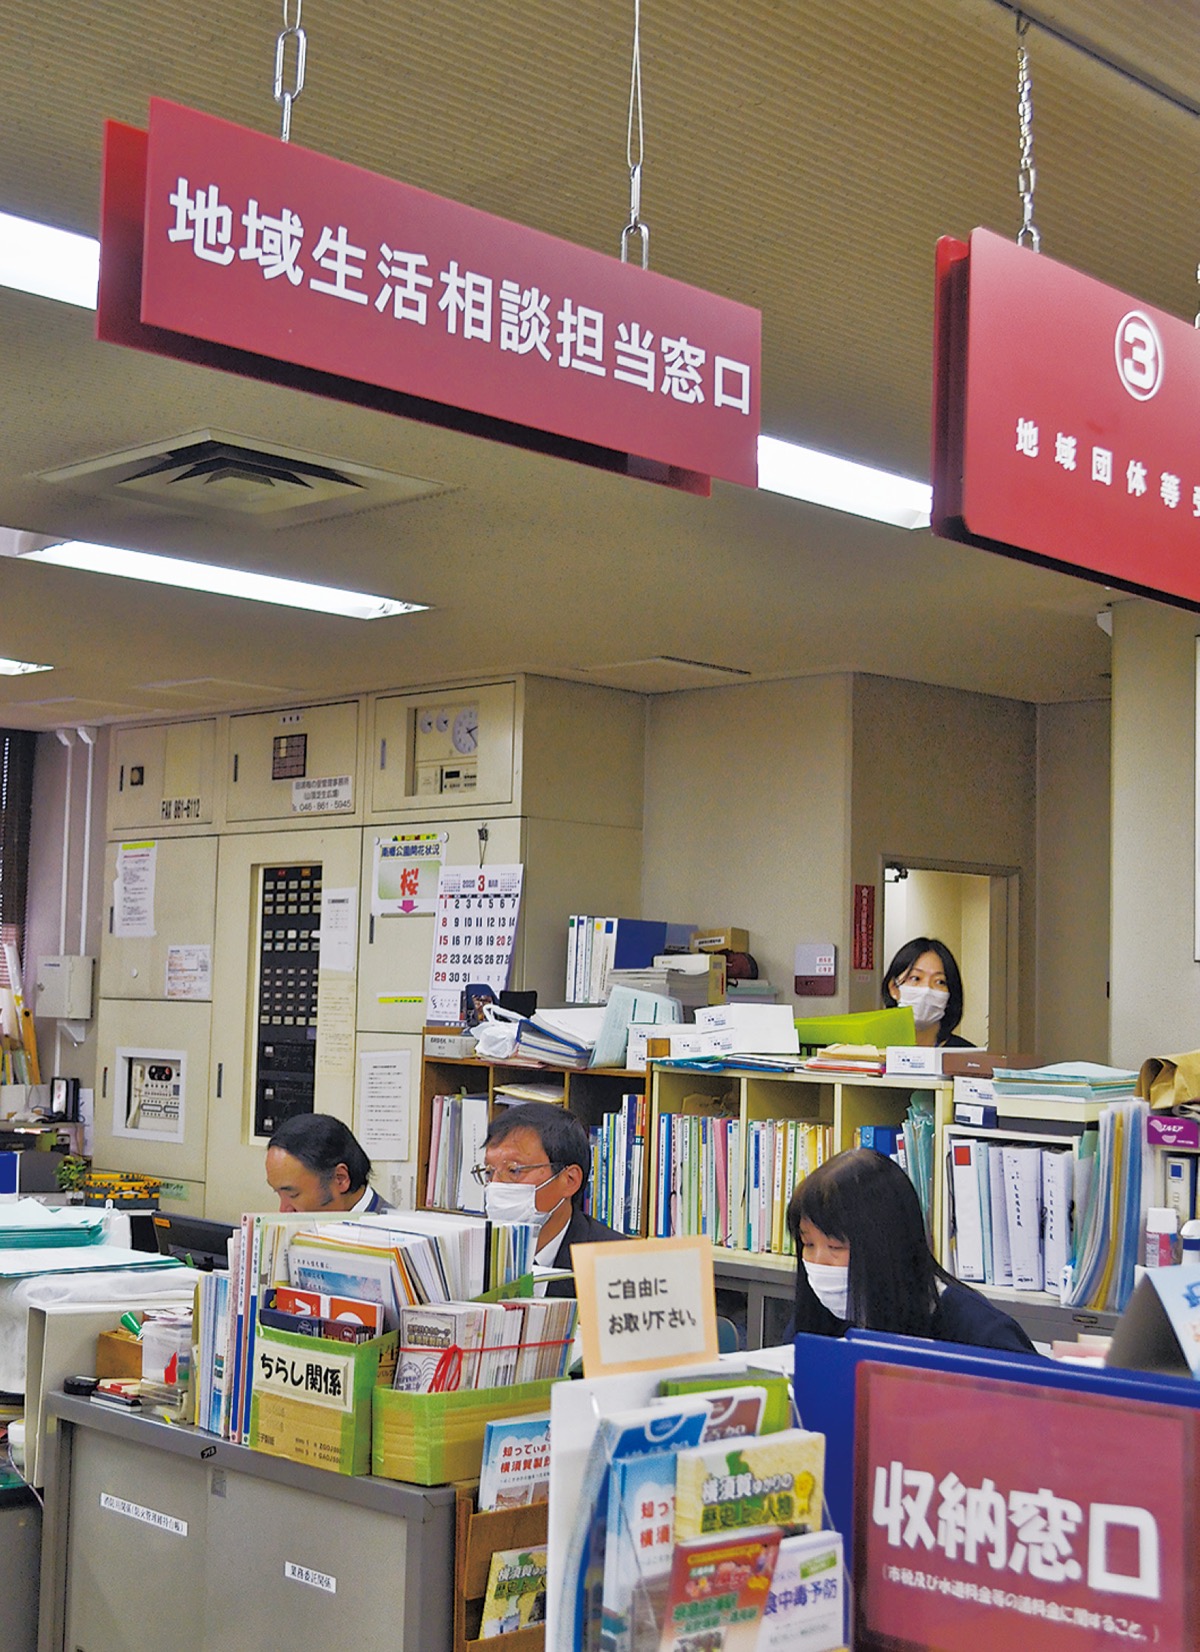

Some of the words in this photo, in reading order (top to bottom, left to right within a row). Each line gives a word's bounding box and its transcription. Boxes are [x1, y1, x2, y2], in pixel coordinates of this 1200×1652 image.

[168, 177, 751, 415] 地域生活相談担当窓口
[400, 867, 419, 896] 桜
[478, 875, 485, 892] 3
[443, 899, 447, 909] 1
[455, 899, 460, 909] 2
[466, 899, 471, 909] 3
[477, 899, 482, 909] 4
[488, 899, 494, 909] 5
[500, 899, 505, 909] 6
[511, 899, 516, 909] 7
[442, 917, 447, 927] 8
[454, 917, 459, 927] 9
[464, 917, 472, 927] 10
[476, 917, 482, 927] 11
[487, 917, 495, 927] 12
[499, 917, 506, 927] 13
[440, 935, 448, 945] 15
[452, 935, 460, 945] 16
[464, 935, 471, 945] 17
[475, 935, 483, 945] 18
[486, 935, 494, 945] 19
[496, 935, 505, 945] 20
[507, 935, 512, 945] 2
[436, 954, 448, 964] 22
[450, 954, 460, 964] 23
[462, 954, 471, 964] 24
[474, 954, 483, 964] 25
[485, 954, 494, 964] 26
[496, 954, 504, 964] 27
[435, 972, 446, 982] 29
[449, 972, 459, 982] 30
[462, 972, 470, 982] 31
[608, 1277, 668, 1299] ご自由に
[608, 1307, 697, 1334] お取り下さい。
[260, 1353, 342, 1397] ちらし関係
[872, 1461, 1161, 1599] 収納窓口
